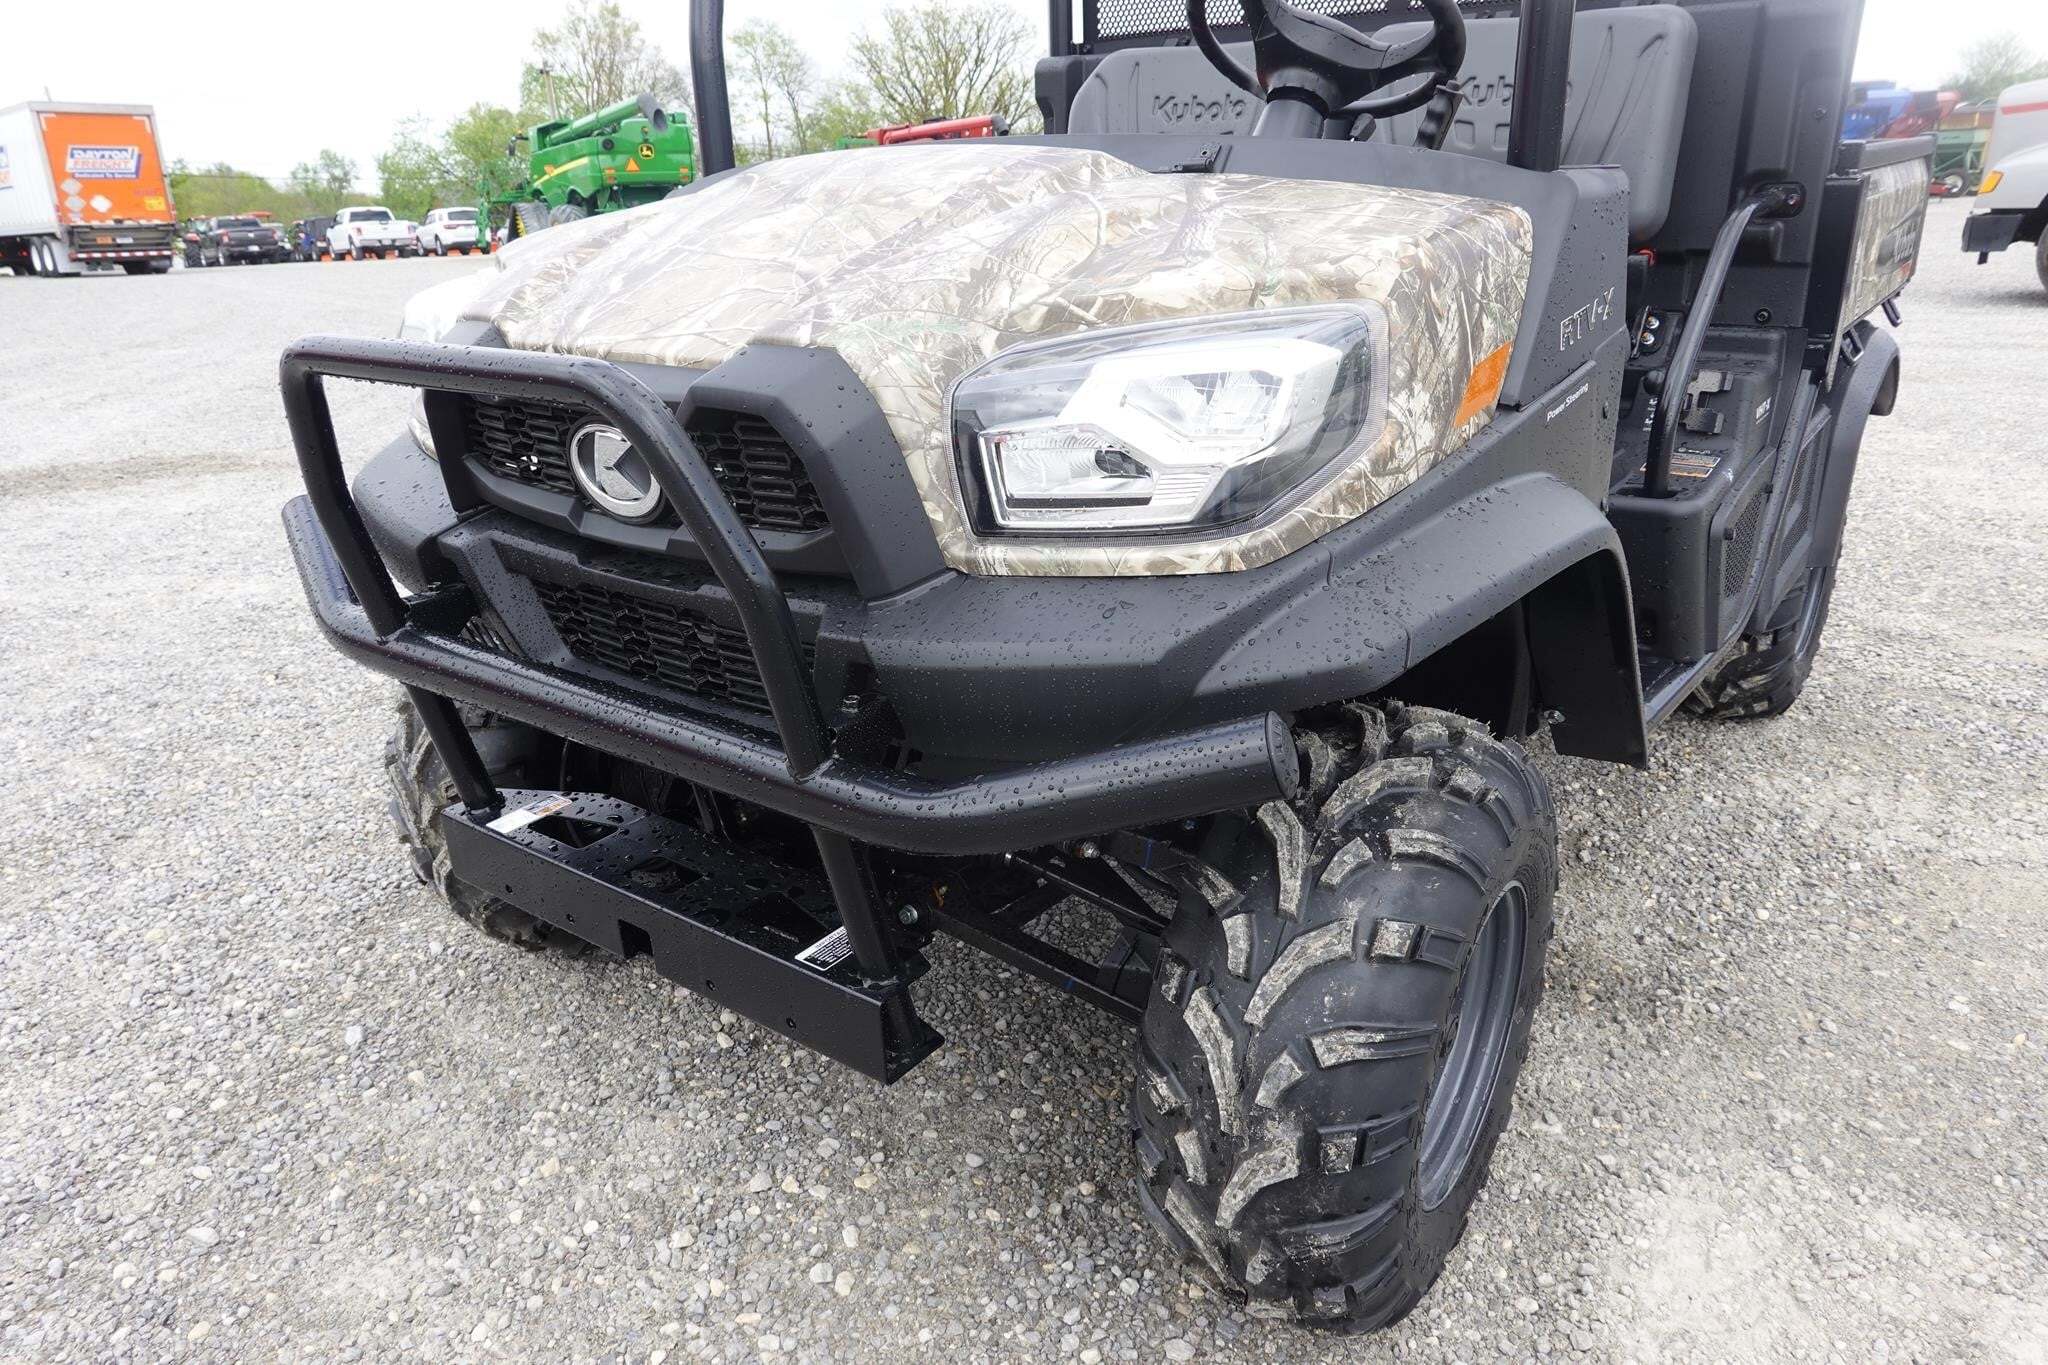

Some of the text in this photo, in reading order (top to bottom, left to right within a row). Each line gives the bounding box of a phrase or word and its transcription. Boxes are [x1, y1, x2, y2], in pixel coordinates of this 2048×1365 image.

[1152, 93, 1246, 124] Kubota
[72, 149, 131, 161] DAYTON
[73, 160, 131, 170] FREIGHT
[1546, 383, 1589, 421] Power Steering
